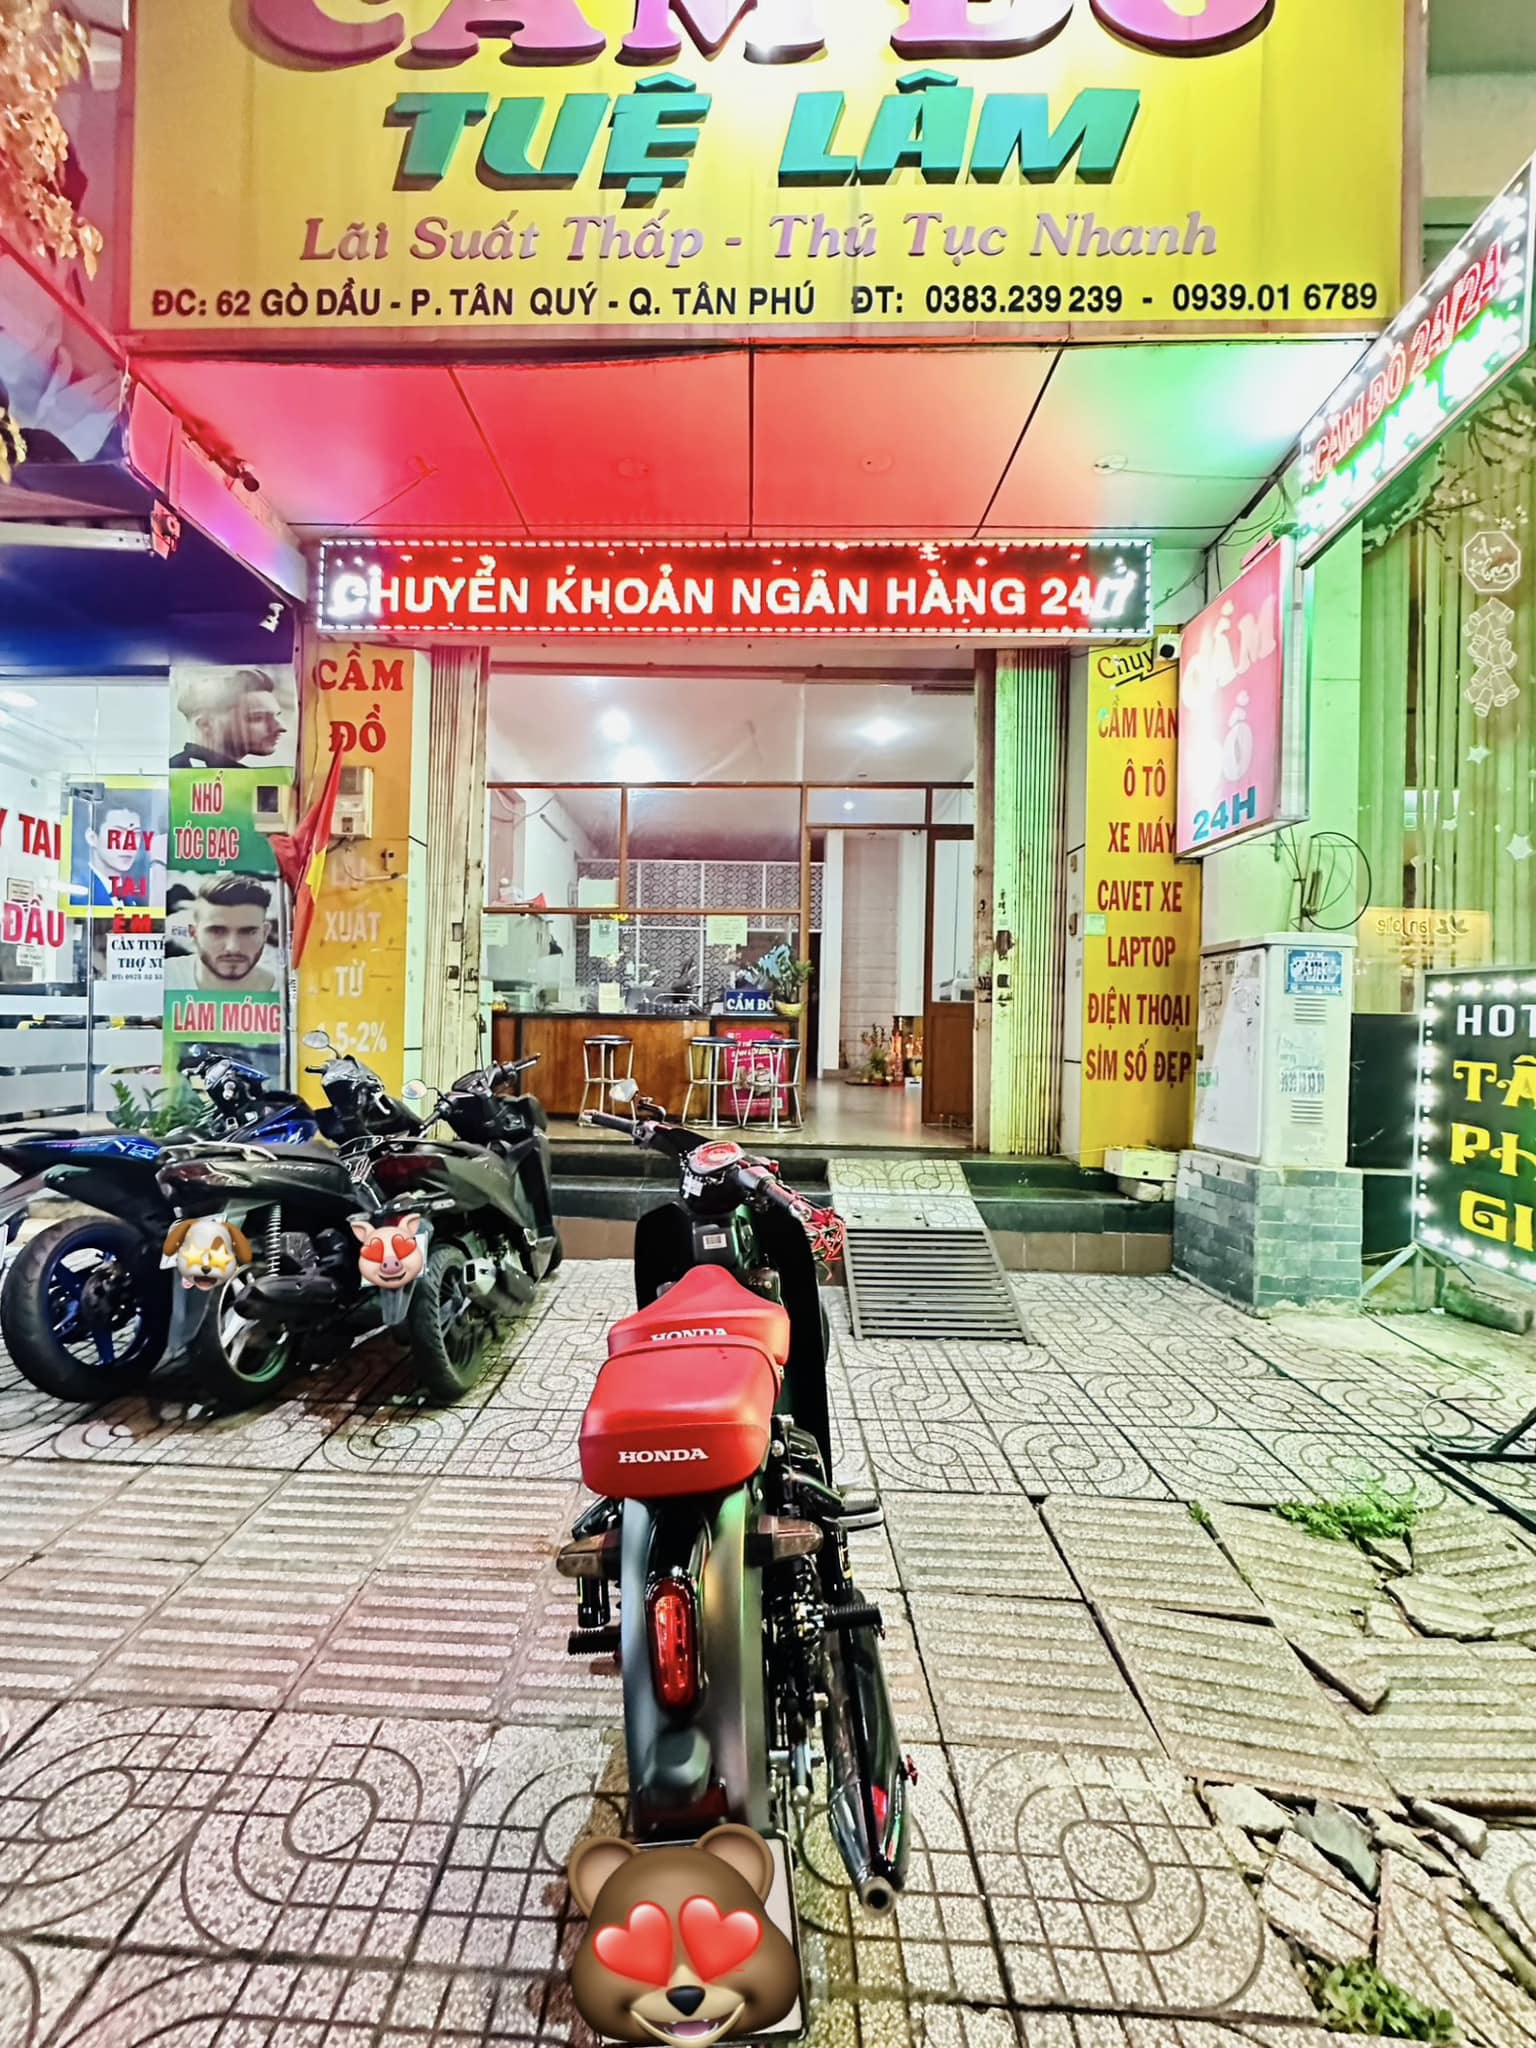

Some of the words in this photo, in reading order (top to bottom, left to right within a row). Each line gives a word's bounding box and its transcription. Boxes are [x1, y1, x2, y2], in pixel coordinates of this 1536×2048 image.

[384, 71, 711, 208] TUỆ
[778, 68, 1141, 187] LÂM
[300, 216, 389, 261] Lãi
[409, 209, 541, 261] Suất
[563, 212, 705, 269] Thấp
[769, 212, 878, 258] Thủ
[903, 211, 1008, 267] Tục
[1029, 210, 1218, 257] Nhanh
[151, 290, 207, 317] ĐC:
[216, 290, 250, 317] 62
[260, 281, 308, 317] GÒ
[316, 277, 381, 317] DẦU
[449, 281, 514, 316] TÂN
[529, 284, 598, 317] QUÝ
[628, 288, 662, 317] Q.
[675, 281, 739, 316] TÂN
[749, 279, 816, 315] PHÚ
[852, 286, 903, 315] ĐT:
[1173, 284, 1290, 312] 0939.01
[1303, 284, 1378, 310] 6789
[326, 555, 529, 618] CHUYỂN
[546, 564, 714, 614] KHOẢN
[731, 568, 869, 615] NGÂN
[886, 568, 1027, 615] HÀNG
[315, 642, 404, 692] CẦM
[1097, 645, 1157, 680] Chuy
[328, 703, 388, 754] ĐỒ
[1143, 701, 1179, 739] VÀN
[1123, 757, 1137, 798] Ô
[1142, 757, 1168, 798] TÔ
[1107, 821, 1131, 854] XE
[1137, 815, 1177, 854] MÁY
[1191, 786, 1257, 842] 24H
[18, 813, 62, 862] TAI
[107, 823, 155, 851] RÁY
[173, 822, 204, 861] TÓC
[207, 827, 241, 867] BẠC
[109, 875, 148, 899] TAI
[1097, 879, 1155, 912] CAVET
[1160, 880, 1184, 913] XE
[2, 893, 66, 949] ĐẦU
[112, 907, 154, 935] ÊM
[324, 902, 382, 944] XUẤT
[117, 956, 147, 973] THỢ
[1107, 935, 1177, 968] LAPTOP
[335, 957, 365, 999] TỪ
[173, 994, 216, 1034] LÀM
[221, 996, 282, 1035] MÓNG
[1087, 985, 1131, 1031] ĐIỆN
[1136, 993, 1191, 1033] THOẠI
[1123, 1038, 1148, 1083] SỐ
[1153, 1050, 1192, 1089] ĐẸP
[651, 1327, 728, 1342] HONDA
[618, 1447, 709, 1464] HONDA
